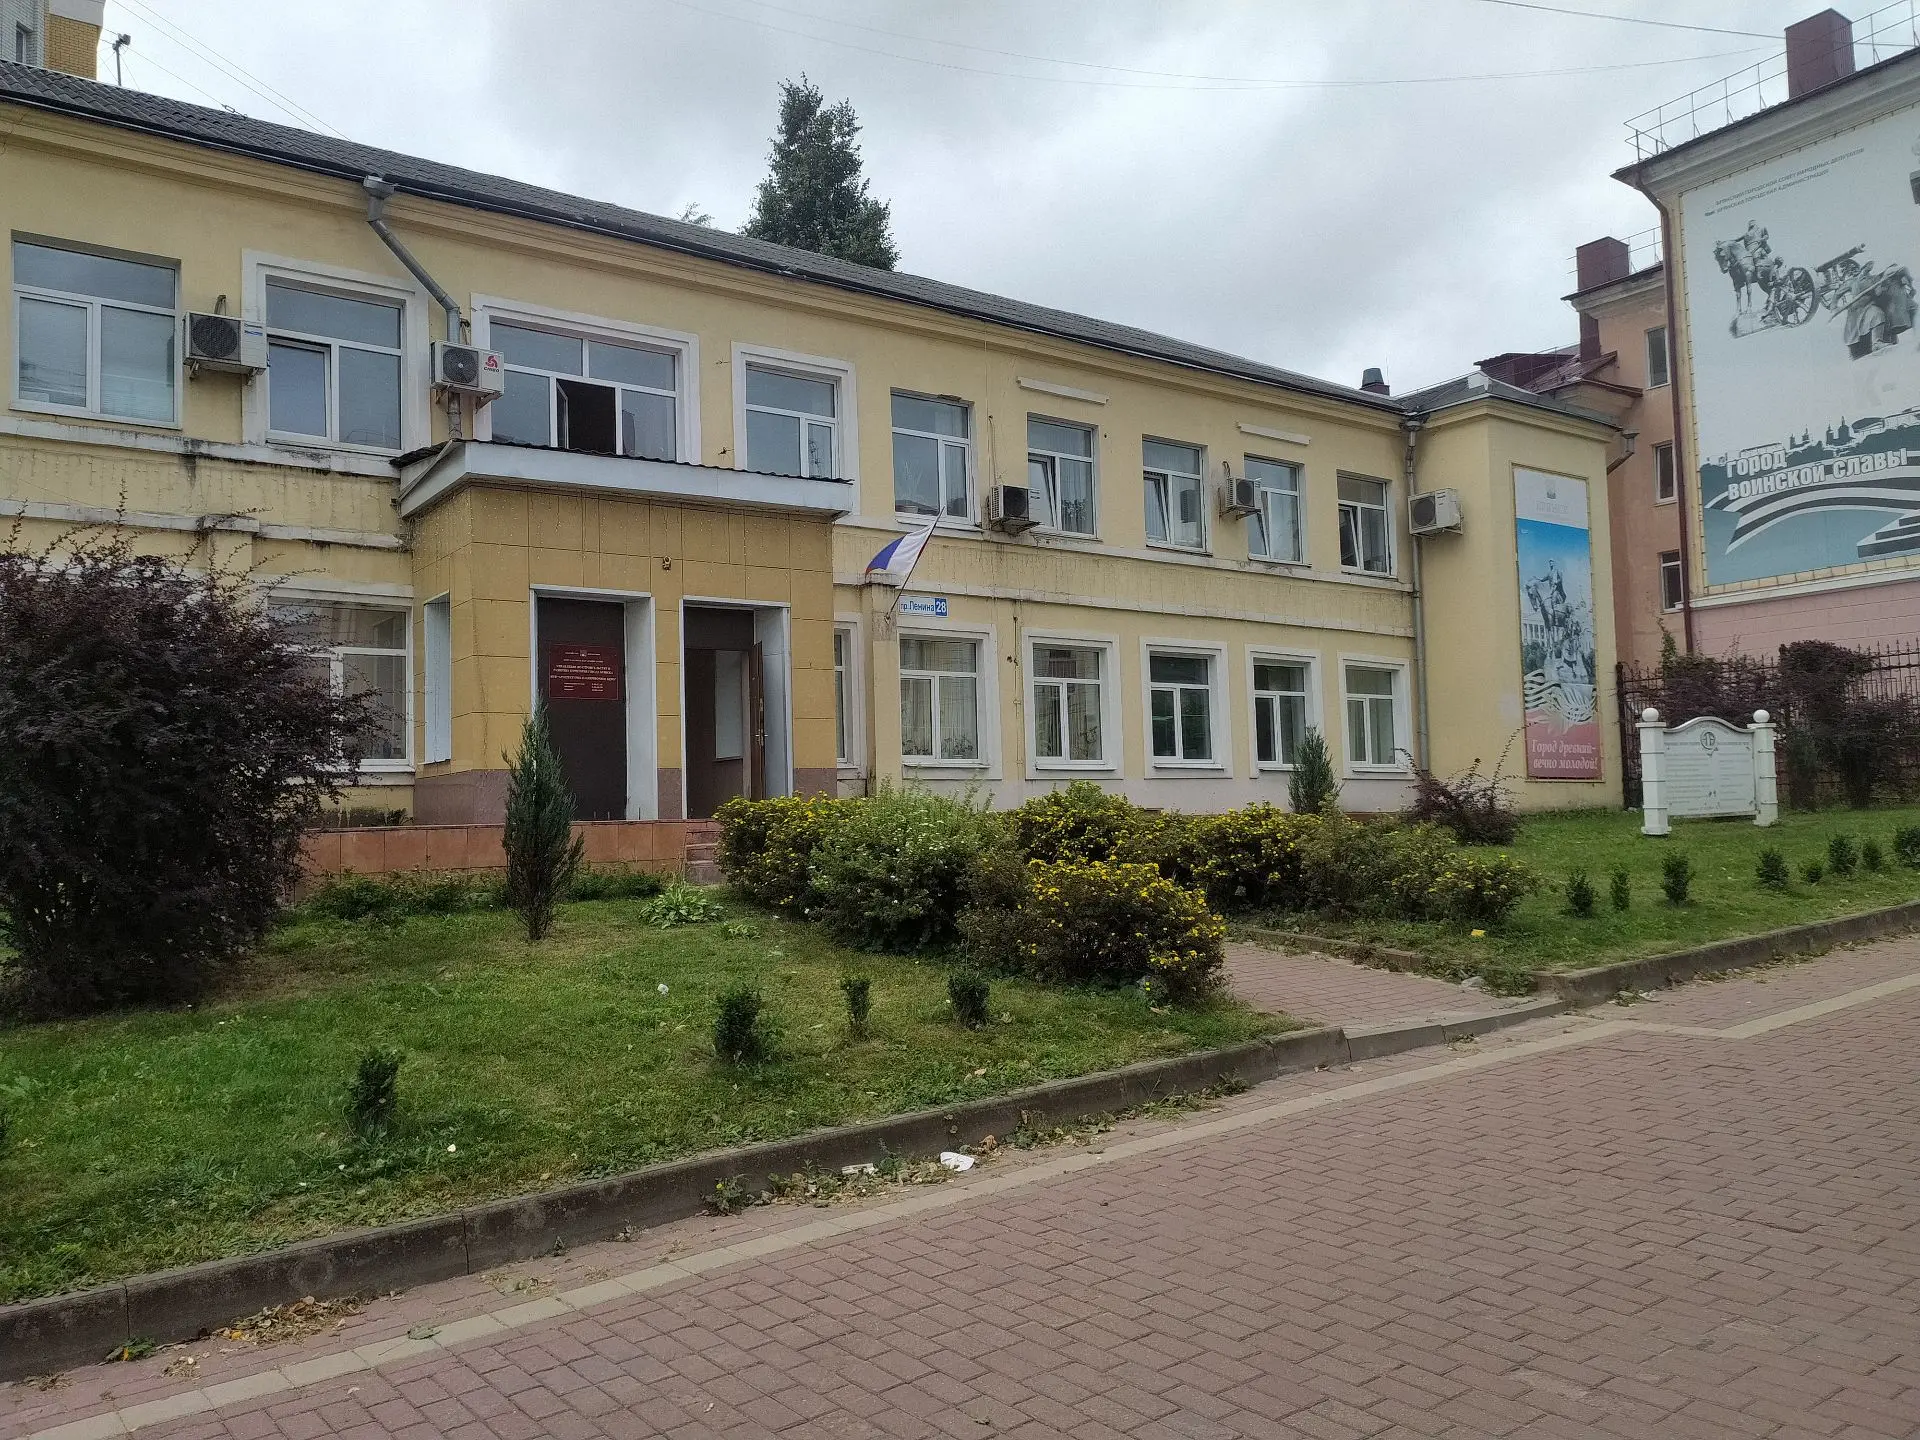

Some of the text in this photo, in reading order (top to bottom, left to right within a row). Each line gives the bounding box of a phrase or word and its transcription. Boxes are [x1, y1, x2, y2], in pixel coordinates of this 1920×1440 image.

[935, 601, 947, 613] 28
[1532, 739, 1558, 757] Город
[1533, 758, 1558, 769] вечно
